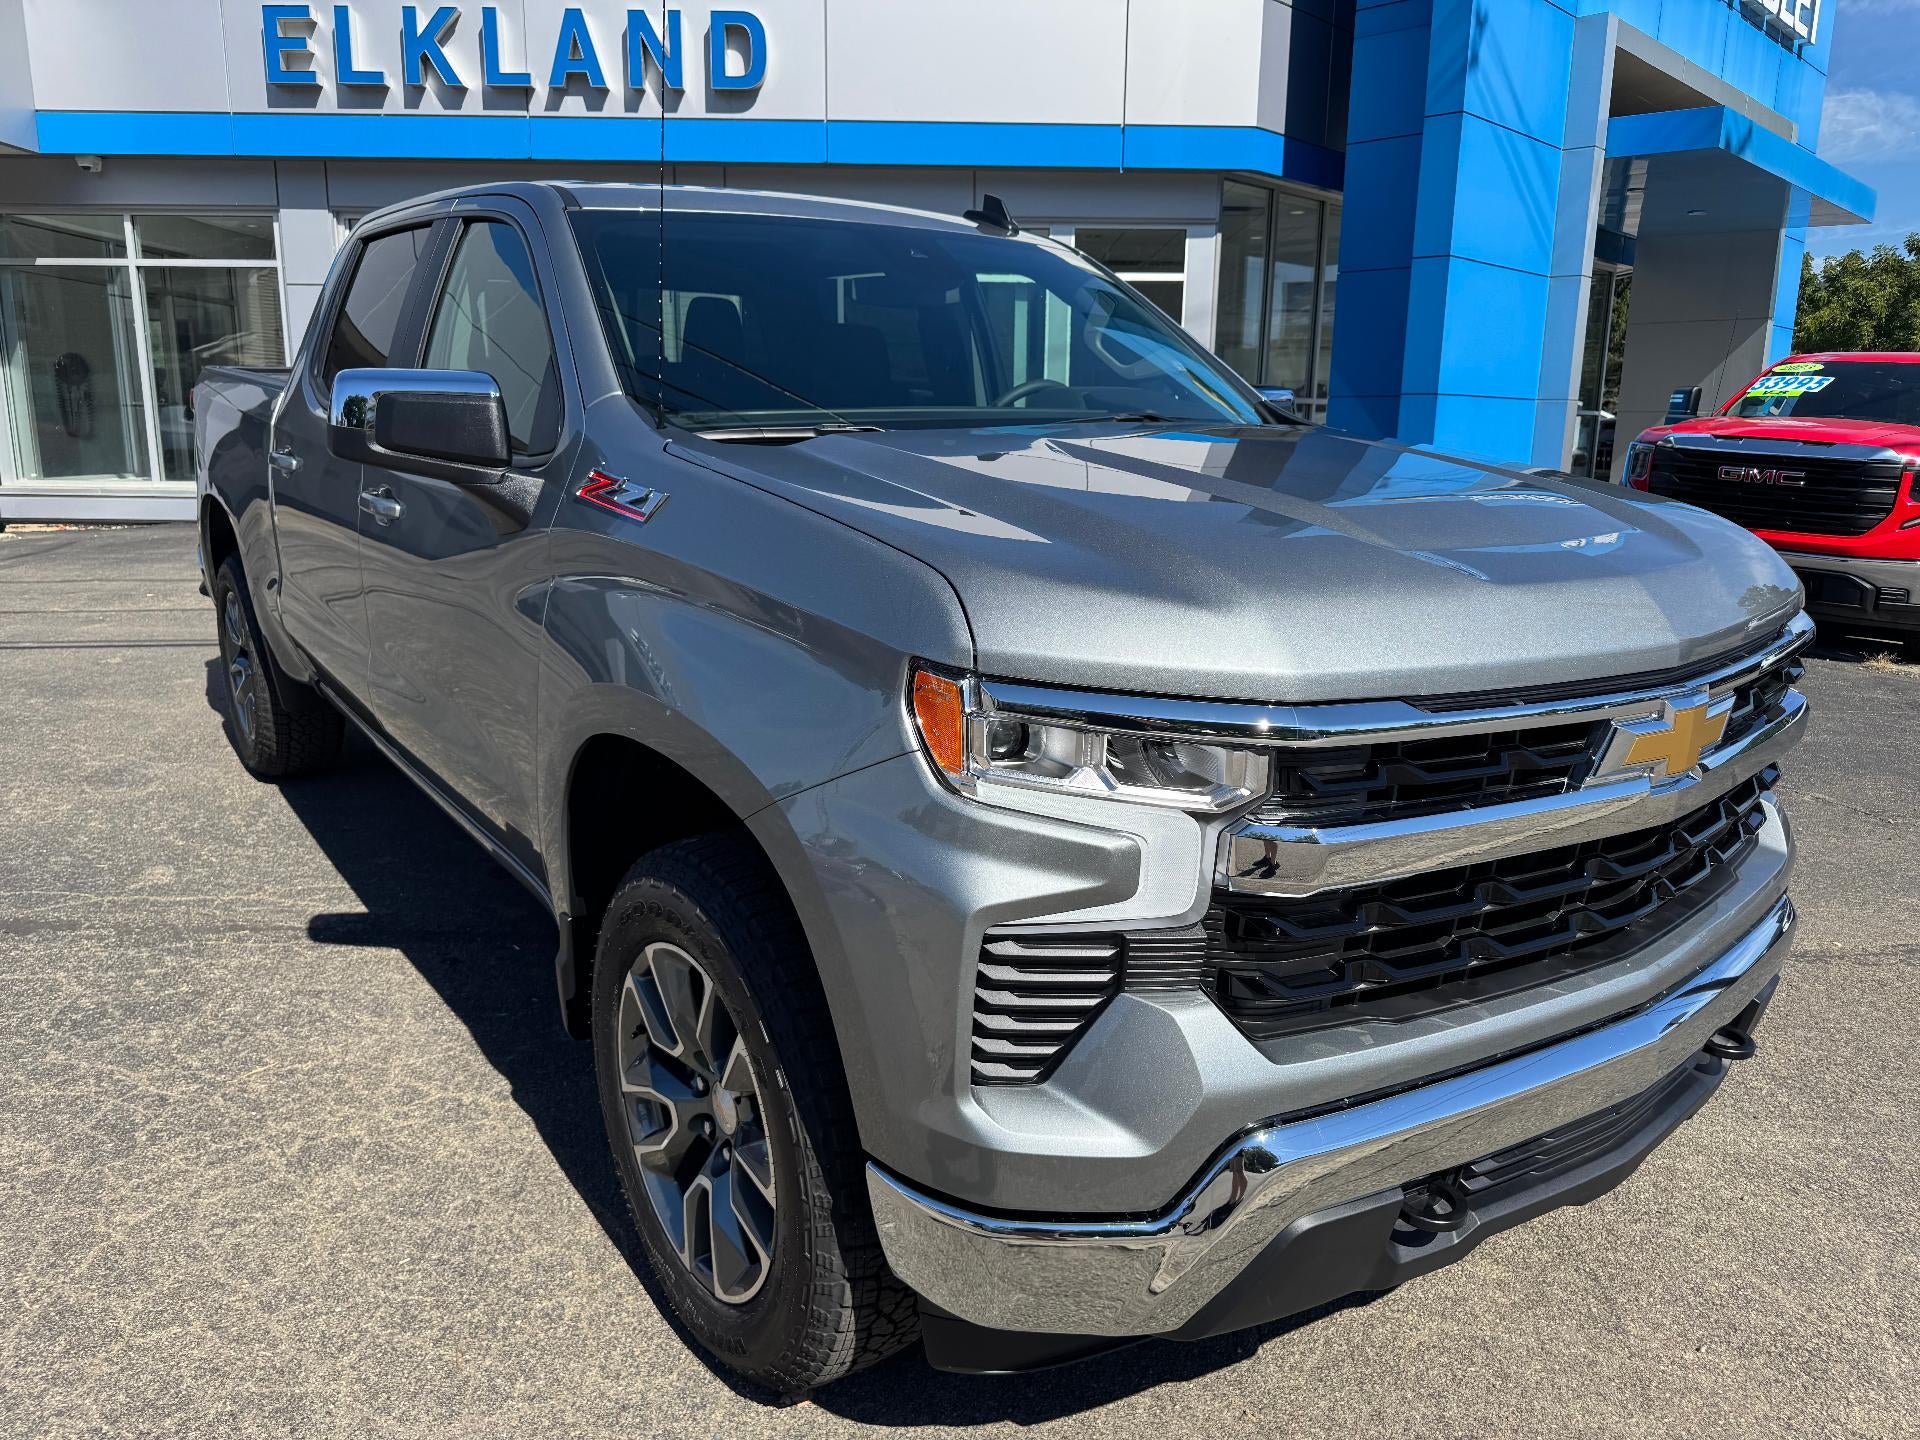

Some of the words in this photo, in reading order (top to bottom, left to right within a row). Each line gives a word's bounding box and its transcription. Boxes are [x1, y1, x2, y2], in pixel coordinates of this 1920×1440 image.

[262, 5, 768, 91] ELKLAND
[1750, 376, 1831, 391] 33995
[1718, 465, 1806, 487] GMC
[575, 468, 671, 524] Z71
